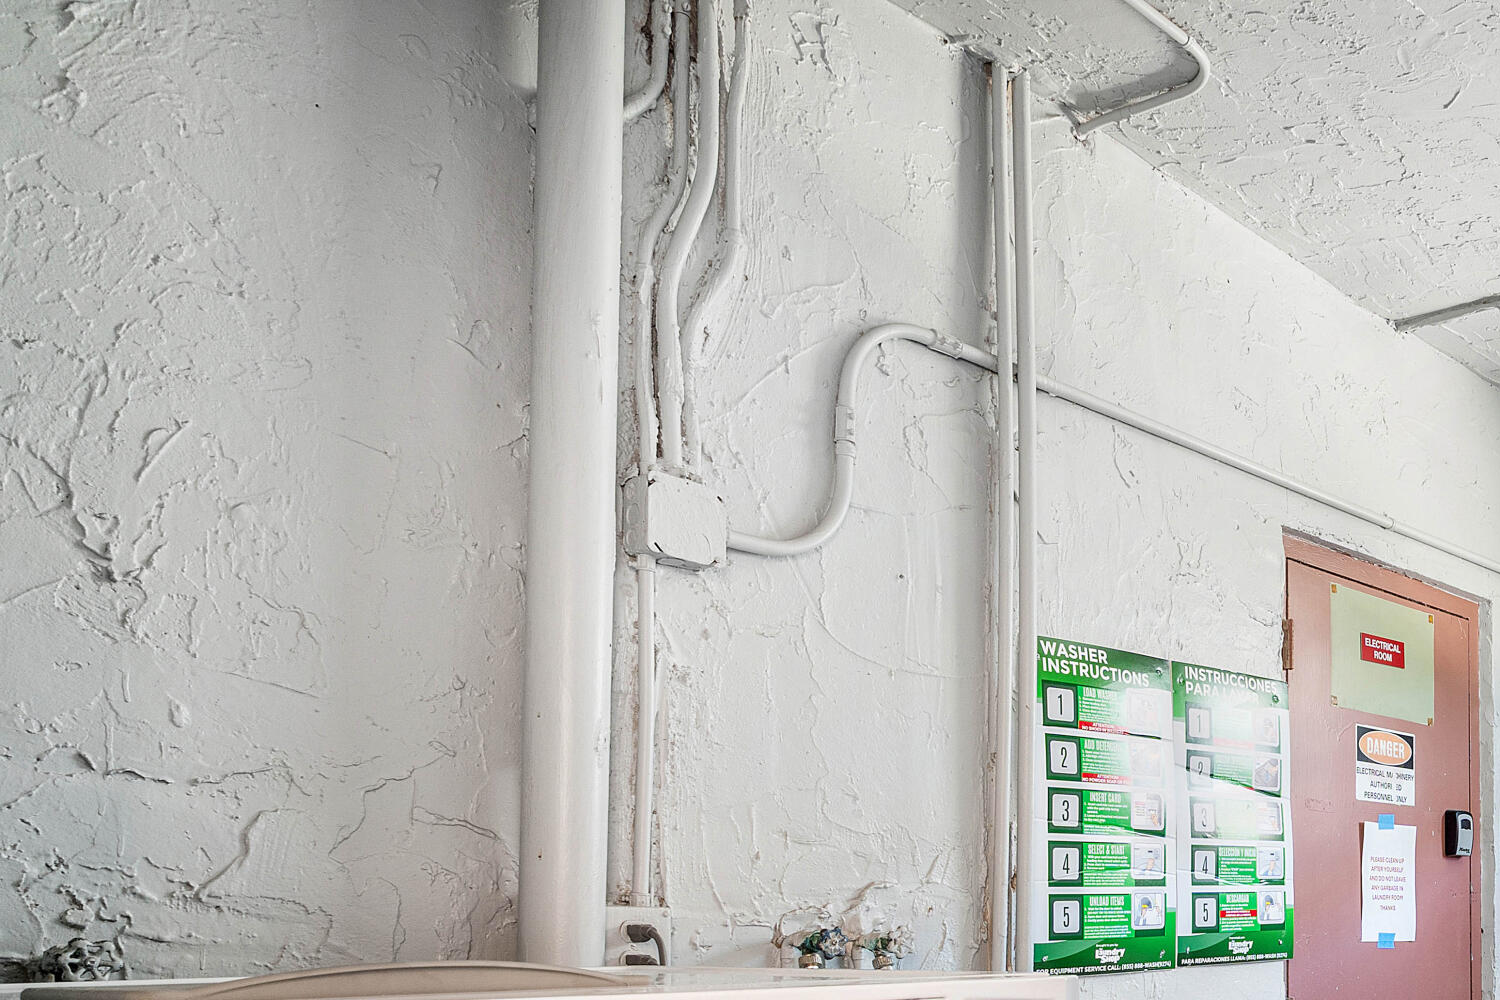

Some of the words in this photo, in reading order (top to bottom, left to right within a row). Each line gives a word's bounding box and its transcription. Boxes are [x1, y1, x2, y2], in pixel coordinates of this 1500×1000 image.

[1040, 640, 1108, 664] WASHER
[1364, 638, 1401, 654] ELECTRICAL
[1374, 650, 1392, 662] ROOM
[1042, 658, 1150, 687] INSTRUCTIONS
[1184, 666, 1276, 694] INSTRUCCIONES
[1058, 694, 1062, 716] 1
[1060, 746, 1068, 768] 2
[1366, 737, 1405, 760] DANGER
[1356, 767, 1385, 777] ELECTRICAL
[1370, 781, 1402, 791] AUTHORIED
[1364, 791, 1393, 802] PERSONNEL
[1062, 800, 1069, 821] 3
[1063, 853, 1070, 874] 4
[1202, 856, 1208, 874] 4
[1063, 907, 1069, 927] 5
[1203, 903, 1208, 922] 5
